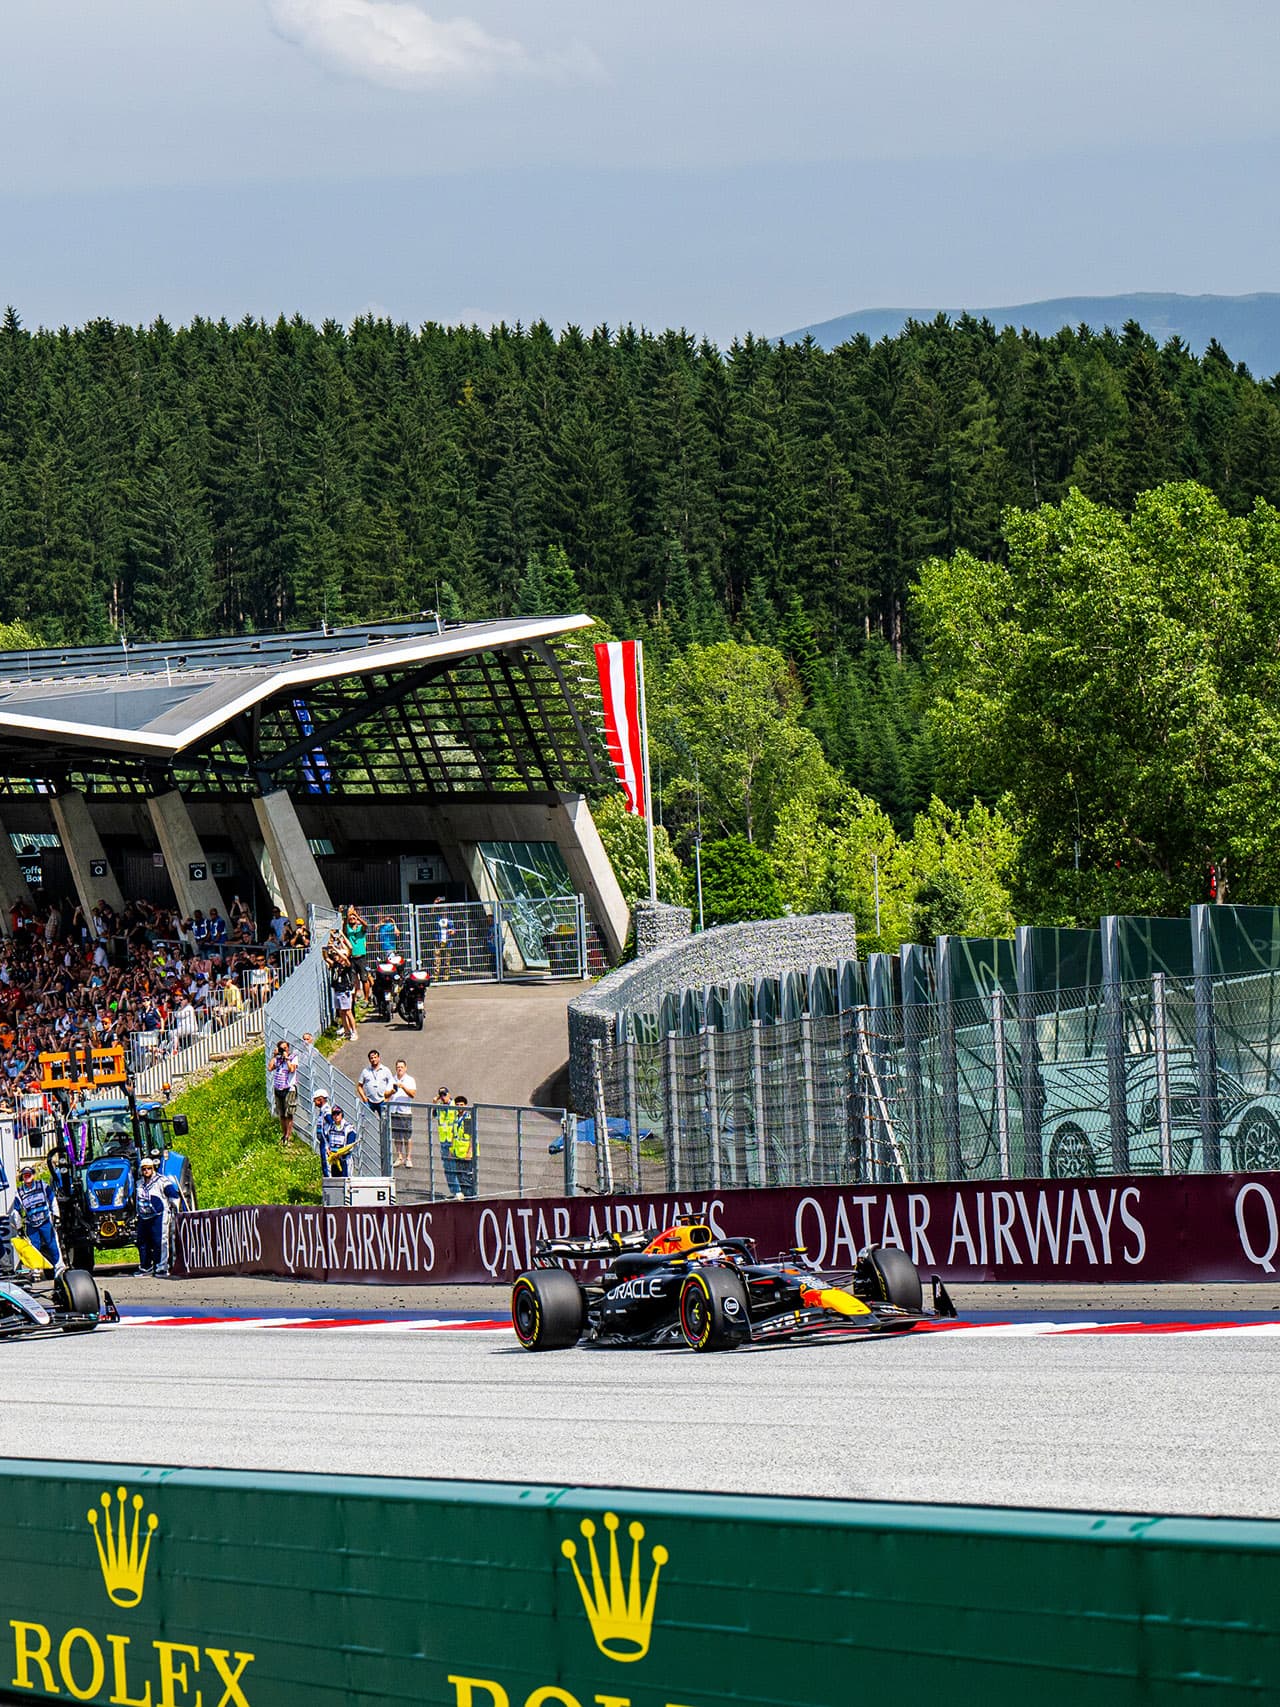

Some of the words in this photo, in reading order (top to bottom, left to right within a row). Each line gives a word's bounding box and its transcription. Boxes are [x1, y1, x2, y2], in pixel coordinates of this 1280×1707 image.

[377, 1191, 386, 1201] B
[180, 1217, 212, 1273] QATAR
[215, 1208, 262, 1268] AIRWAYS
[283, 1212, 340, 1273] QATAR
[344, 1212, 435, 1272] AIRWAYS
[478, 1207, 577, 1277] QATAR
[795, 1193, 936, 1272] QATAR
[948, 1187, 1147, 1266] AIRWAYS
[606, 1279, 667, 1300] ORACLE
[9, 1619, 256, 1707] ROLEX
